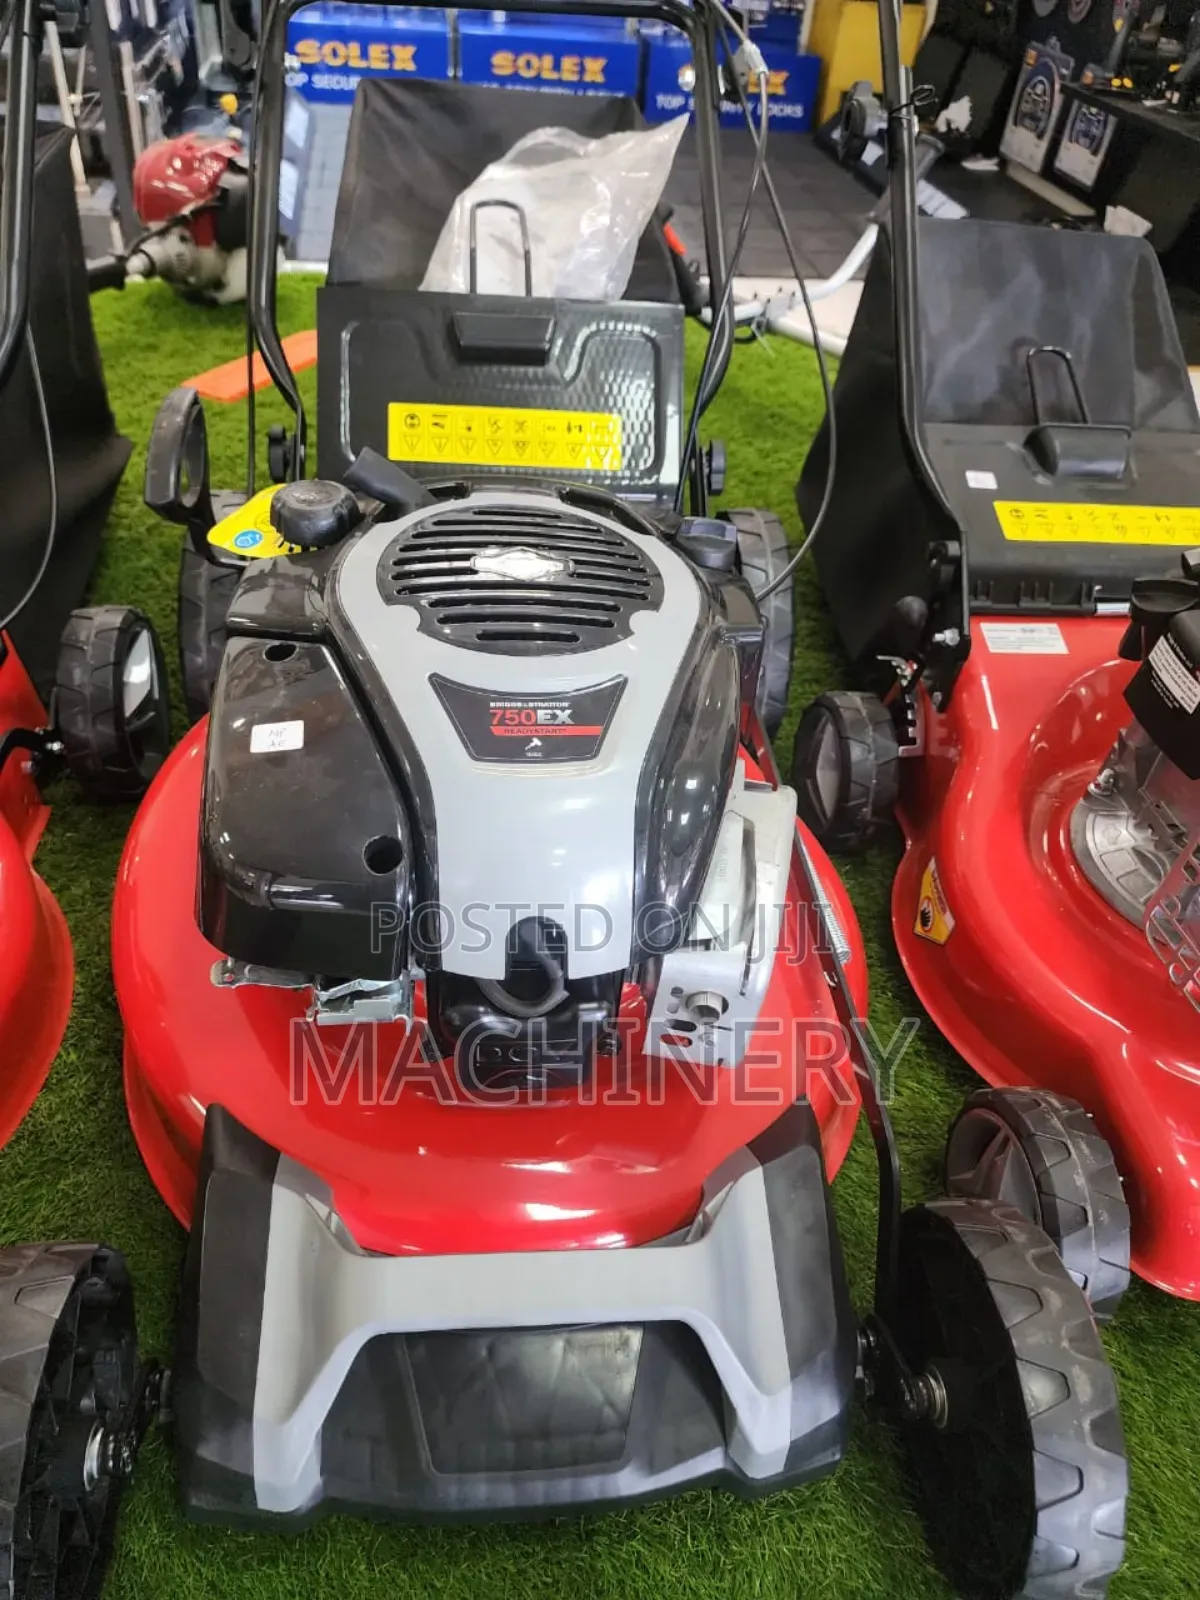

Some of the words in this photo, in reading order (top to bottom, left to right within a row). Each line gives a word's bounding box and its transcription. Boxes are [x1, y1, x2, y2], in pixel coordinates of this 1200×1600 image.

[295, 38, 417, 71] SOLEX
[491, 51, 607, 84] SOLEX
[489, 709, 575, 726] 750EX
